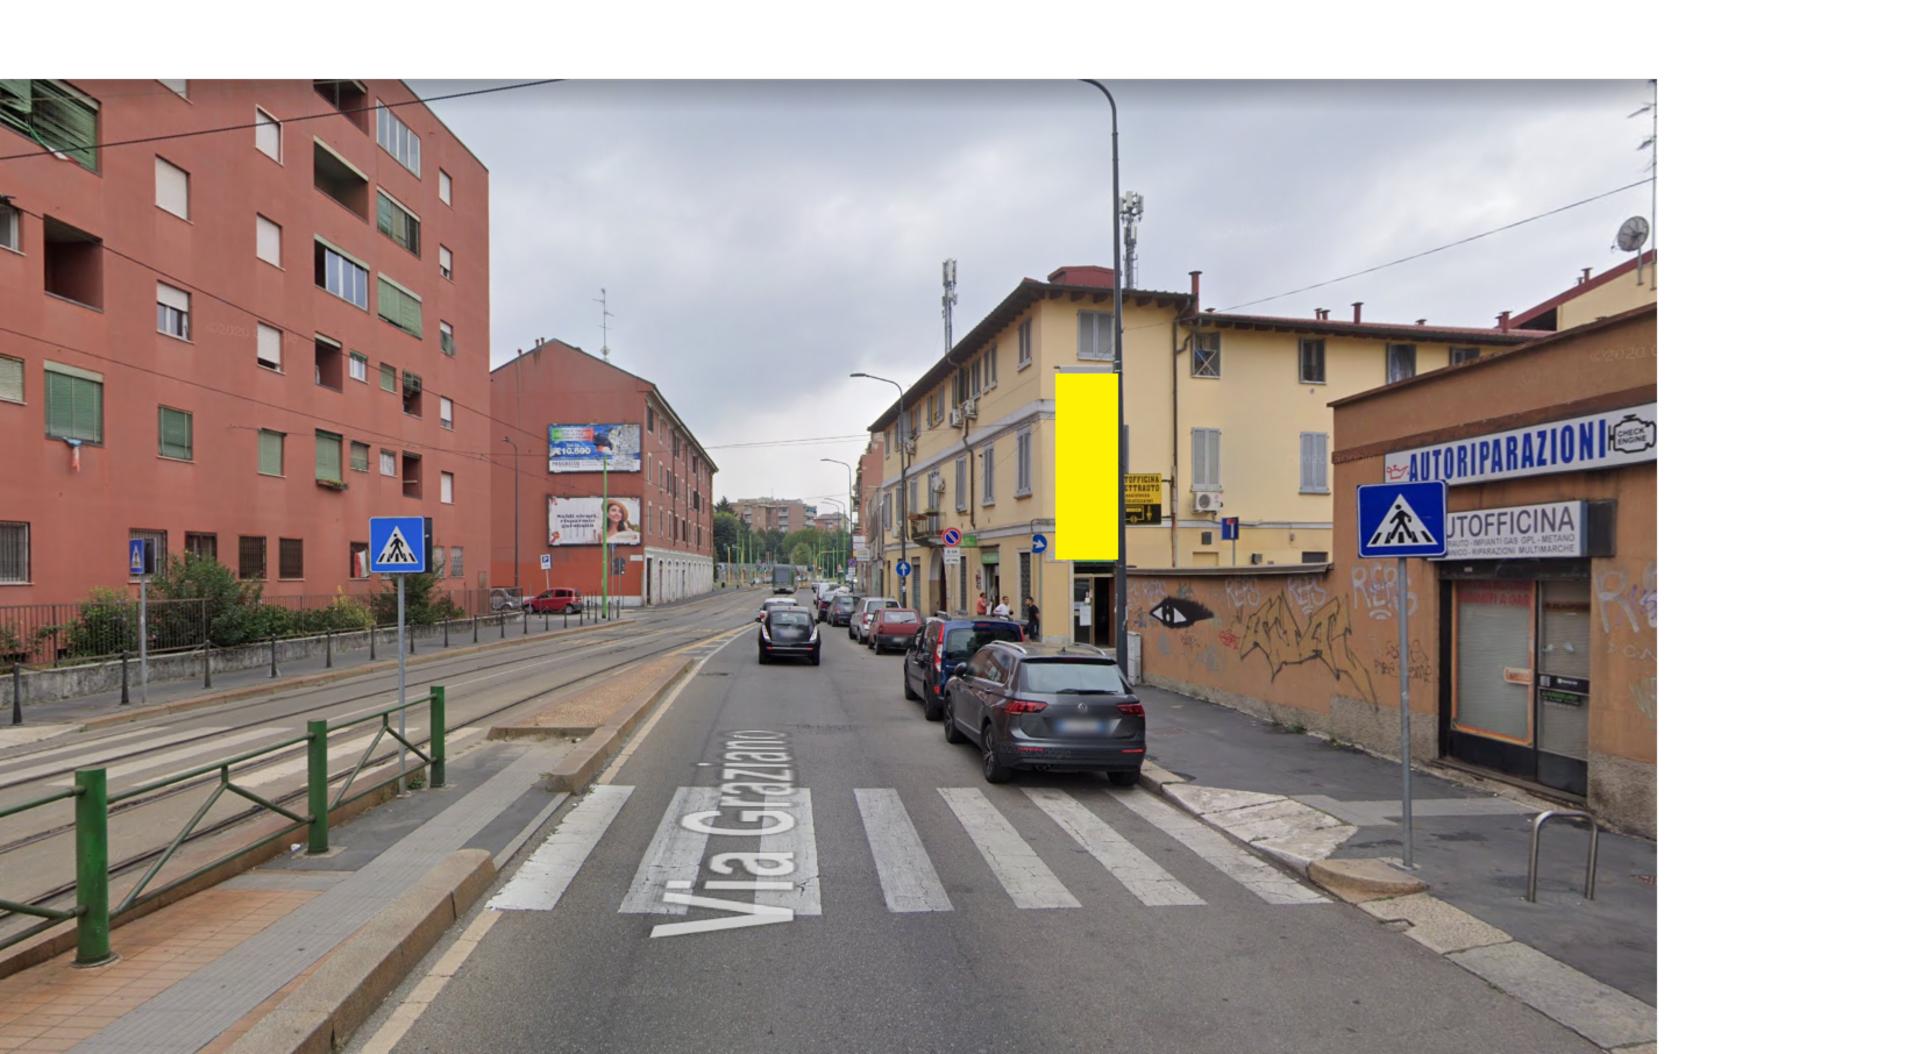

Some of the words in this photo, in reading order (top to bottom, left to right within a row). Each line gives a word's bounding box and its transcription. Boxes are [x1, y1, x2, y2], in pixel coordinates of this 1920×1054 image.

[1617, 427, 1645, 438] CHECK
[1617, 435, 1646, 446] ENGINE
[1408, 418, 1607, 482] AUTORIPARAZIONI
[1446, 505, 1575, 539] UTOFFICINA
[1541, 533, 1576, 543] METANO
[1472, 545, 1516, 555] RIPARAZIONI
[1518, 543, 1576, 553] MULTIMARCHE
